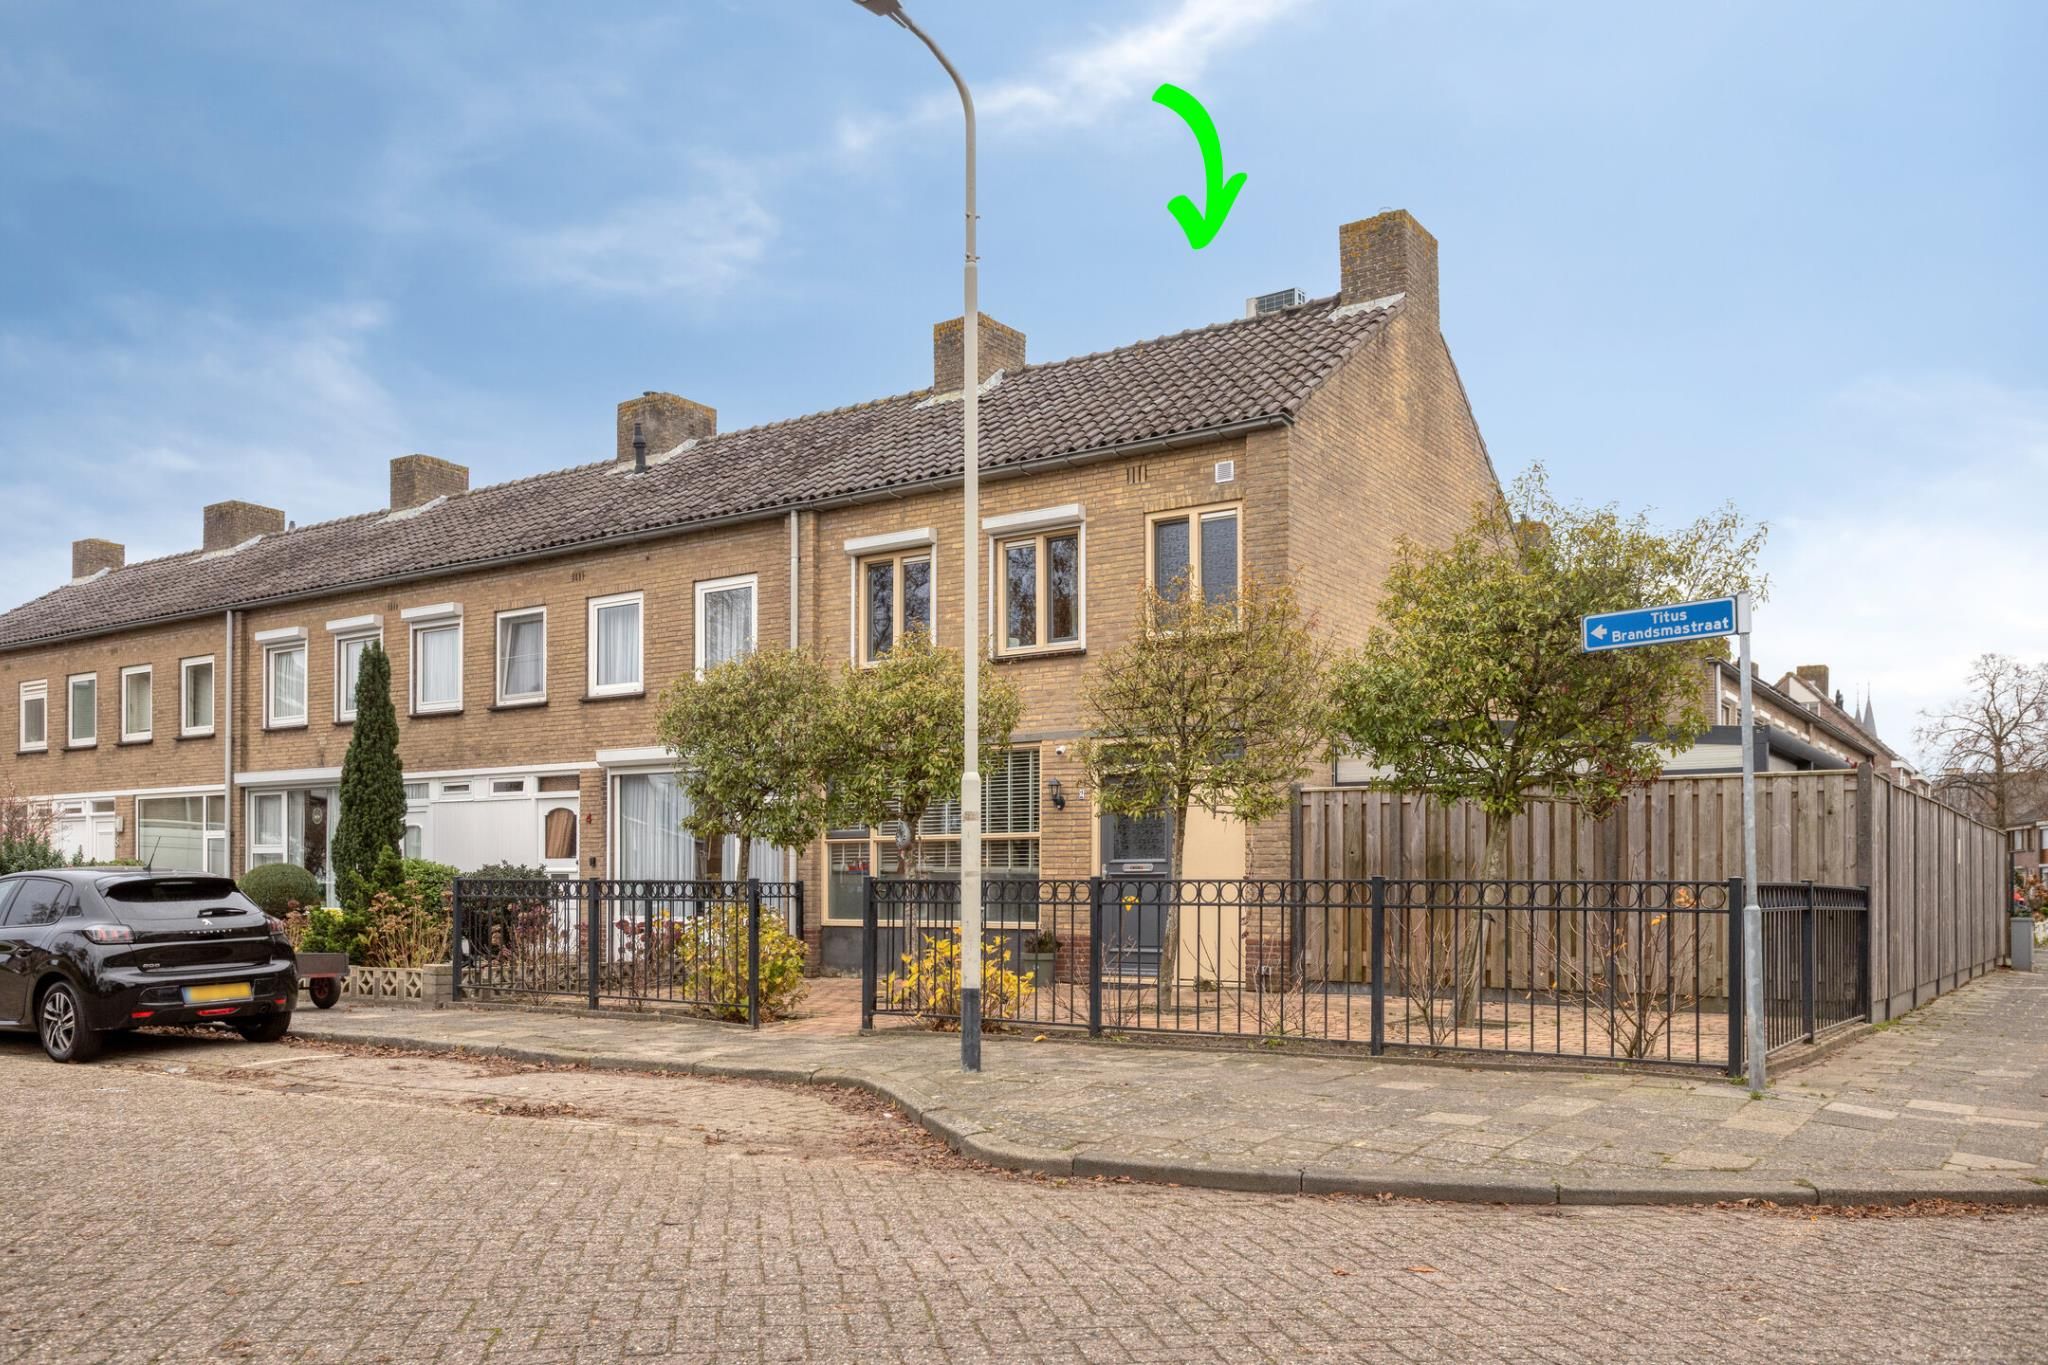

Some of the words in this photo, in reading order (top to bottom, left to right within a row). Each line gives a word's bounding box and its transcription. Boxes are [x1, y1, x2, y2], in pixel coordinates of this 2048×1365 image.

[1650, 611, 1687, 624] Titus
[1612, 617, 1729, 642] Brandsmastraat
[586, 812, 592, 824] 4
